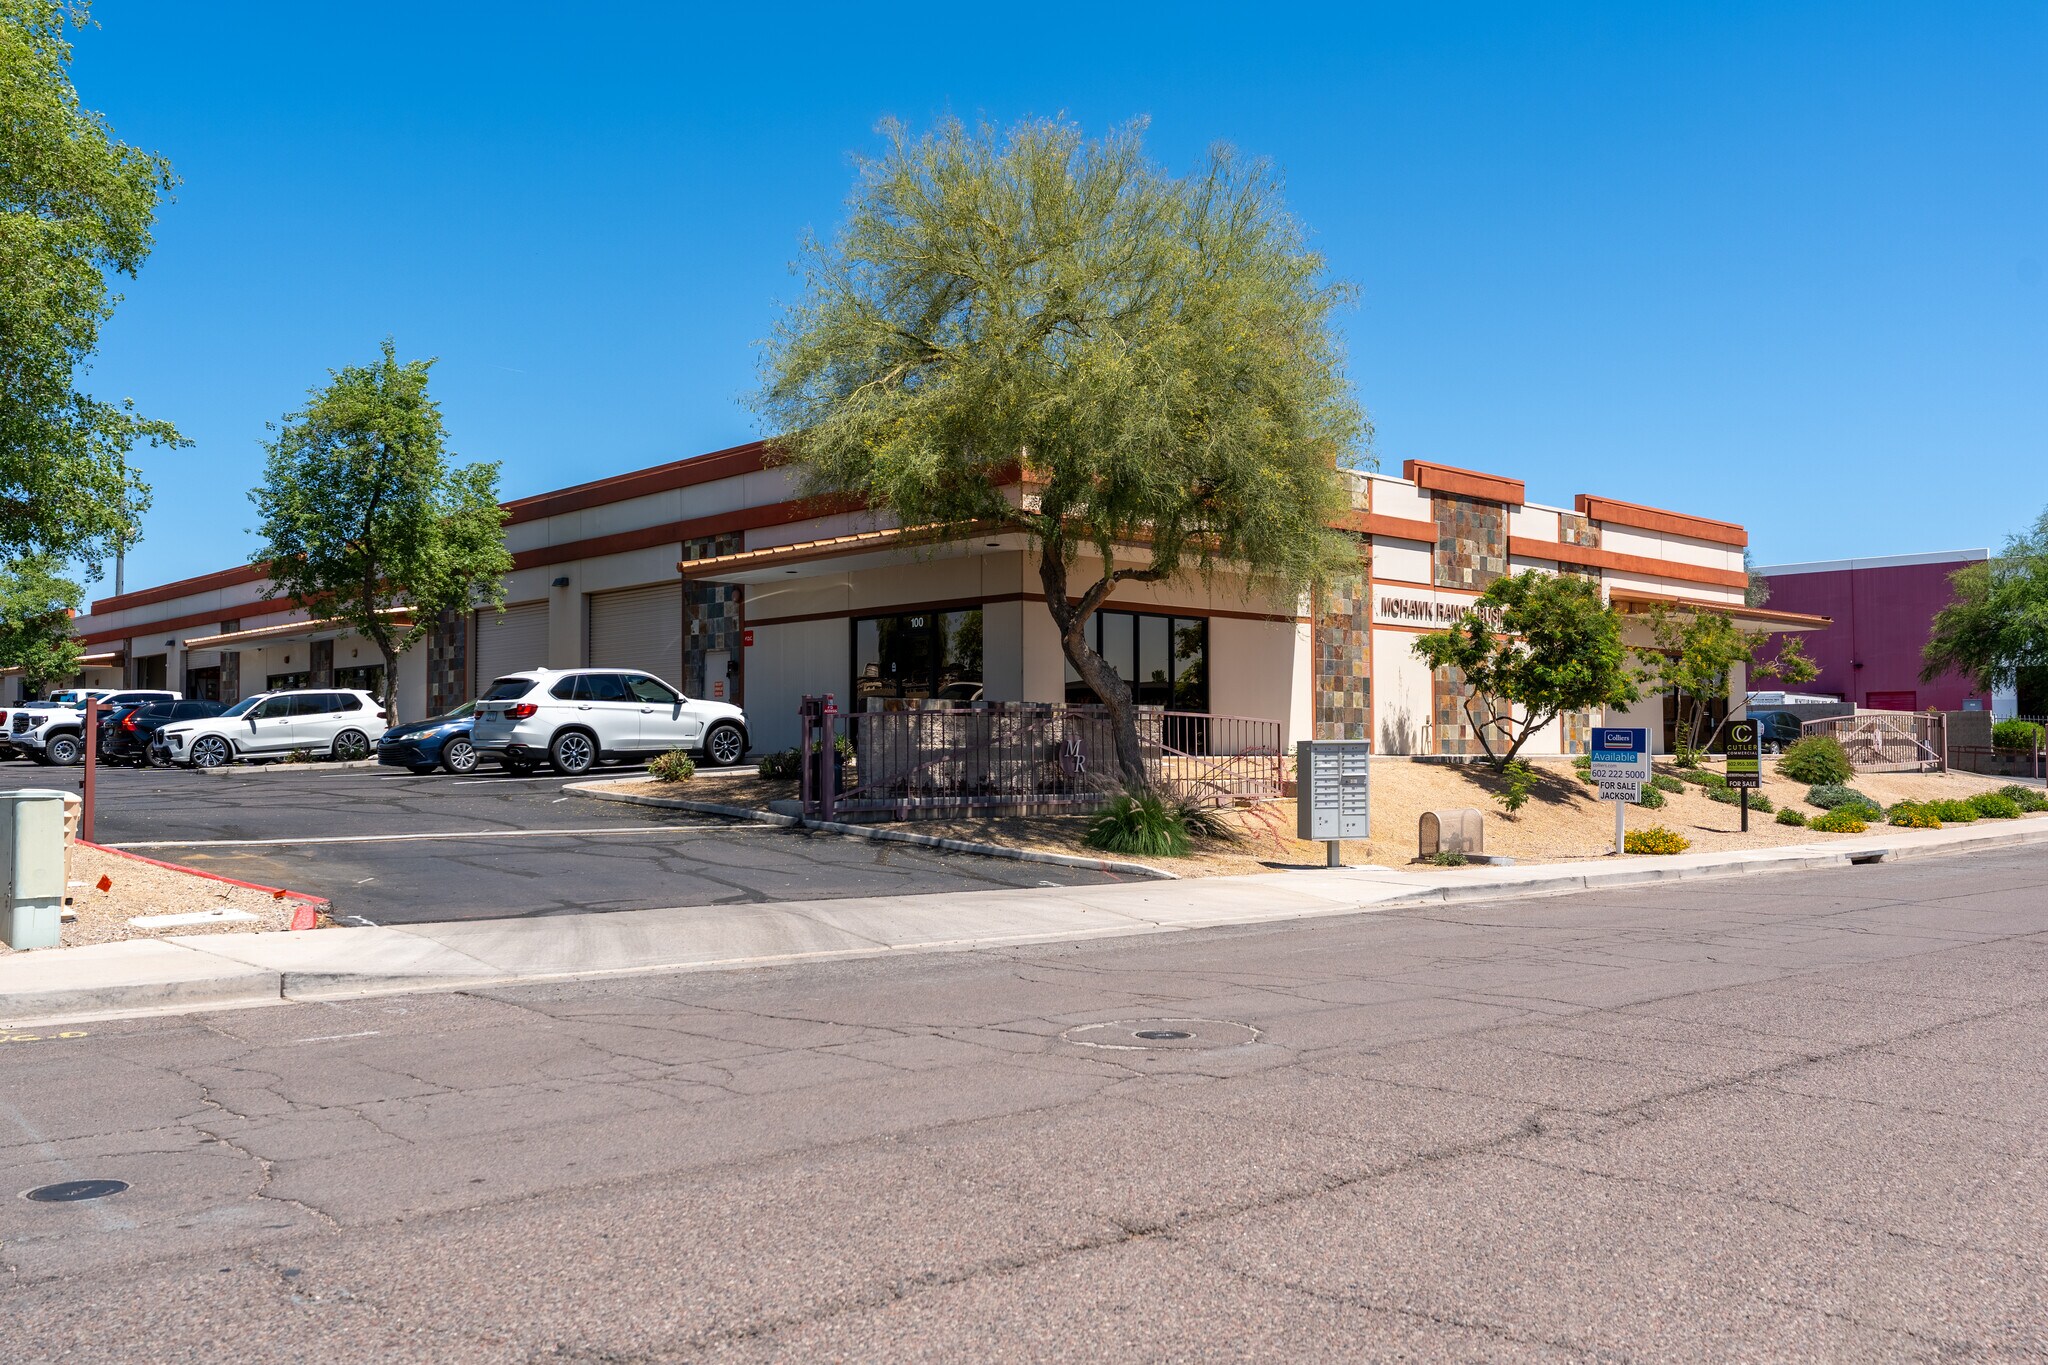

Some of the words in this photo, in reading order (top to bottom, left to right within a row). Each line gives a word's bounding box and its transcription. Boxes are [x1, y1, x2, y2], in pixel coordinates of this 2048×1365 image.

[1381, 597, 1433, 620] MOHAWK
[911, 617, 924, 628] 100
[1607, 733, 1630, 742] Colliers
[1593, 752, 1636, 762] Available
[1592, 769, 1607, 778] 602
[1608, 770, 1623, 779] 222
[1625, 770, 1646, 779] 5000
[1600, 781, 1616, 790] FOR
[1616, 782, 1636, 791] SALE
[1600, 792, 1636, 801] JACKSON
